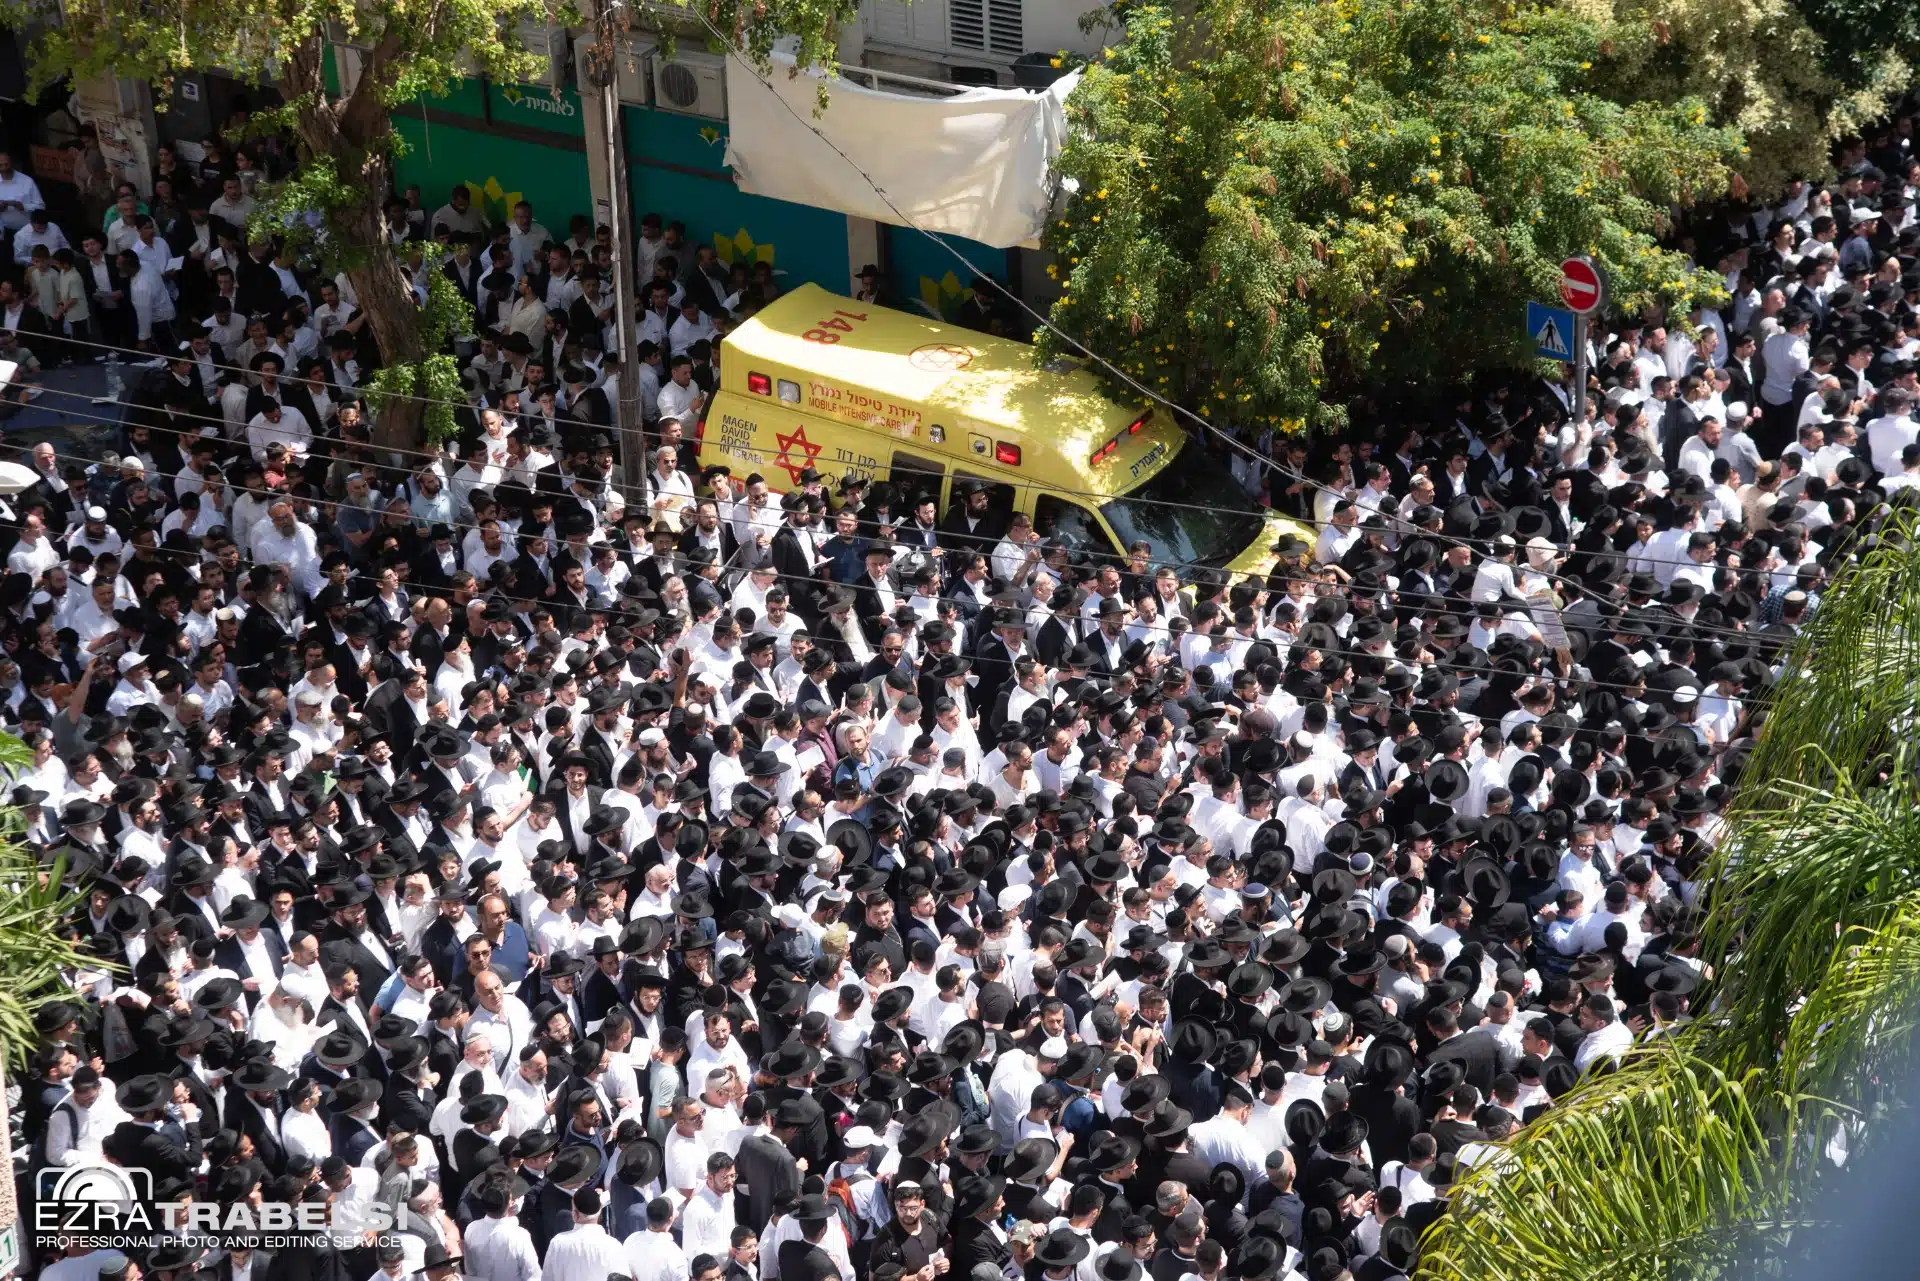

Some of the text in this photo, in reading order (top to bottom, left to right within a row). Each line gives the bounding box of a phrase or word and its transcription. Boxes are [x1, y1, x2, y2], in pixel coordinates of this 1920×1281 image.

[525, 96, 576, 117] לאומית
[801, 309, 869, 345] 148
[808, 381, 922, 423] ניידת טיפול נמרץ
[722, 413, 758, 433] MAGEN
[808, 396, 838, 413] MOBILE
[839, 404, 881, 424] INTENSIVE
[880, 415, 902, 431] CARE
[720, 434, 751, 449] ADOM
[721, 424, 751, 442] DAVID
[719, 444, 764, 465] IN ISRAEL
[836, 447, 877, 470] מגן דוד
[1129, 443, 1165, 477] פראמדיק
